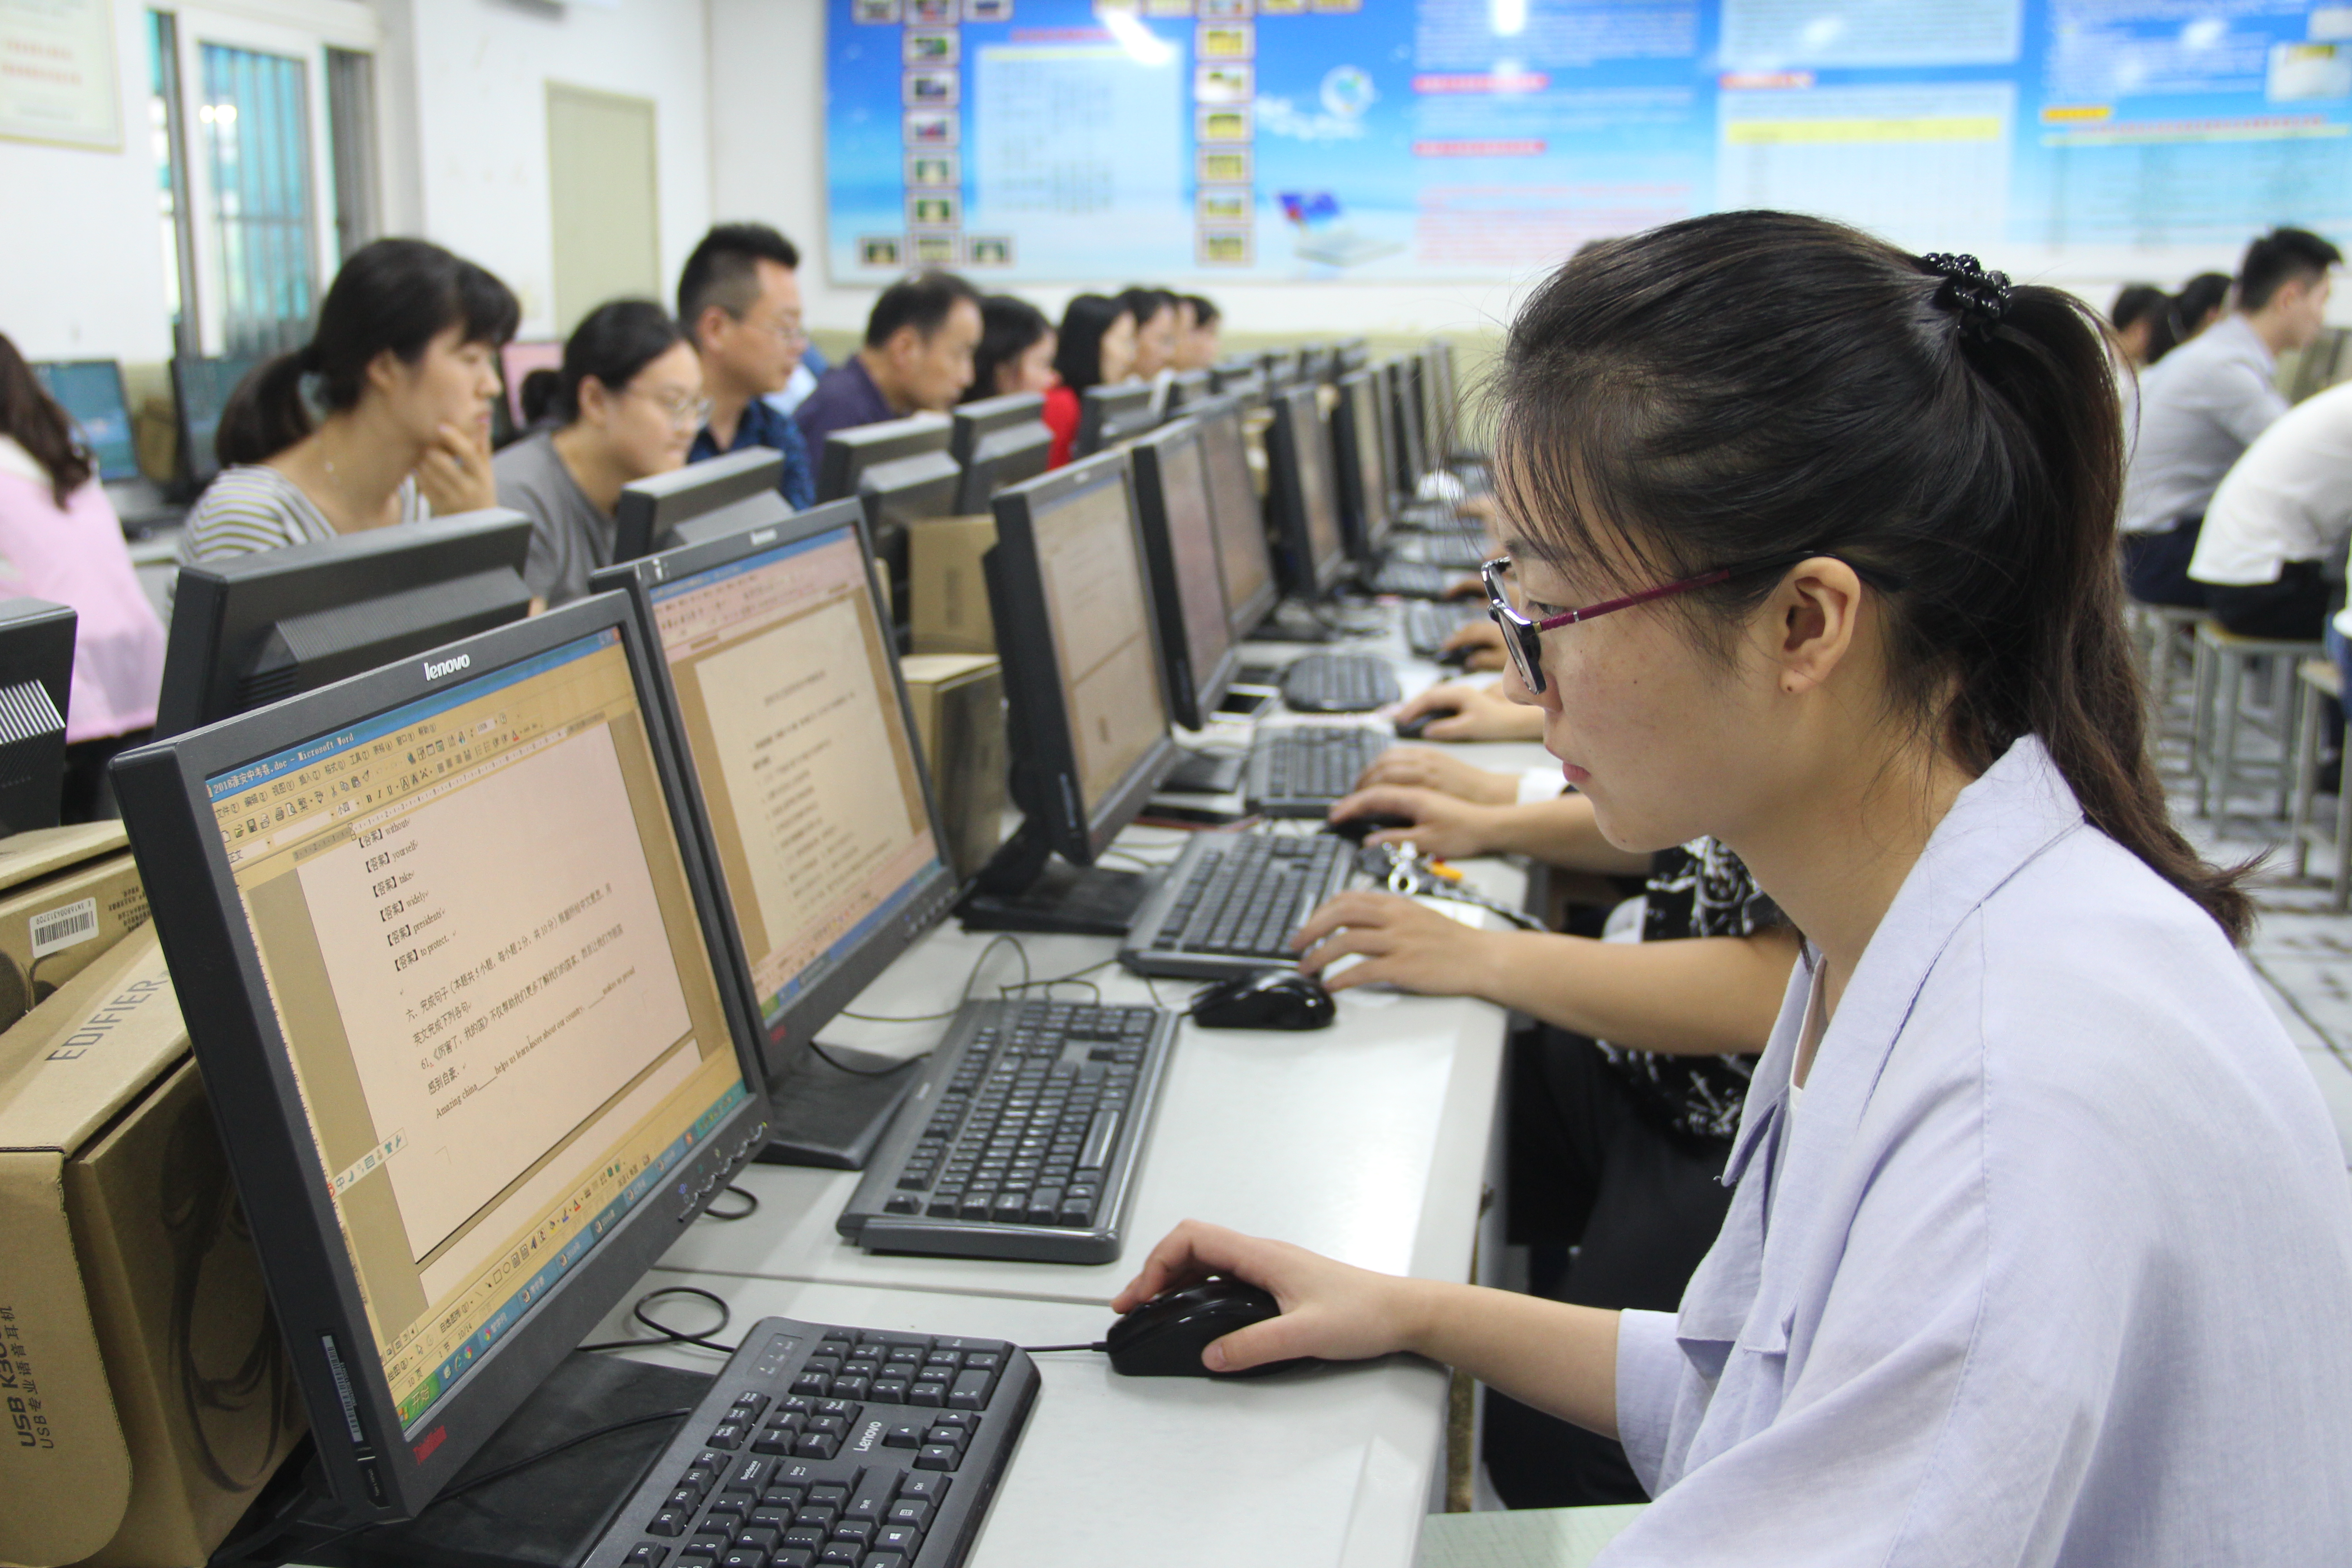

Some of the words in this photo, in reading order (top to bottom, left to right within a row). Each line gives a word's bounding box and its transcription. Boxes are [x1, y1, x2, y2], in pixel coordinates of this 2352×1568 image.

[424, 654, 470, 681] lenovo
[297, 739, 335, 762] Microsoft
[336, 731, 354, 747] Word
[336, 801, 350, 815] 小四
[358, 828, 383, 850] 【答案】
[384, 817, 408, 836] without
[365, 851, 390, 873] 【答案】
[391, 839, 417, 862] yourself
[372, 875, 397, 899] 【答案】
[398, 869, 412, 884] take
[380, 899, 404, 923] 【答案】
[405, 889, 427, 910] widely
[387, 923, 412, 947] 【答案】
[394, 948, 419, 972] 【答案】
[421, 949, 427, 957] to
[44, 980, 169, 1061] EDIFIER
[412, 999, 470, 1048] 英文完成下列各句
[435, 1093, 462, 1121] Amazing
[494, 1058, 509, 1077] helps
[509, 1054, 516, 1064] us
[515, 1043, 529, 1059] learn
[529, 1034, 543, 1049] more
[542, 1022, 557, 1040] about
[556, 1017, 565, 1029] our
[336, 1176, 345, 1189] 中
[458, 1321, 472, 1340] 10/14
[443, 1341, 451, 1353] 节
[408, 1376, 415, 1387] 10
[415, 1367, 423, 1381] 页
[410, 1382, 431, 1413] 开始
[8, 1396, 36, 1446] USB
[853, 1421, 882, 1452] Lenovo
[703, 1452, 714, 1461] F12
[689, 1472, 700, 1480] F11
[675, 1491, 687, 1500] F10
[661, 1514, 672, 1522] F9
[638, 1547, 649, 1555] F8
